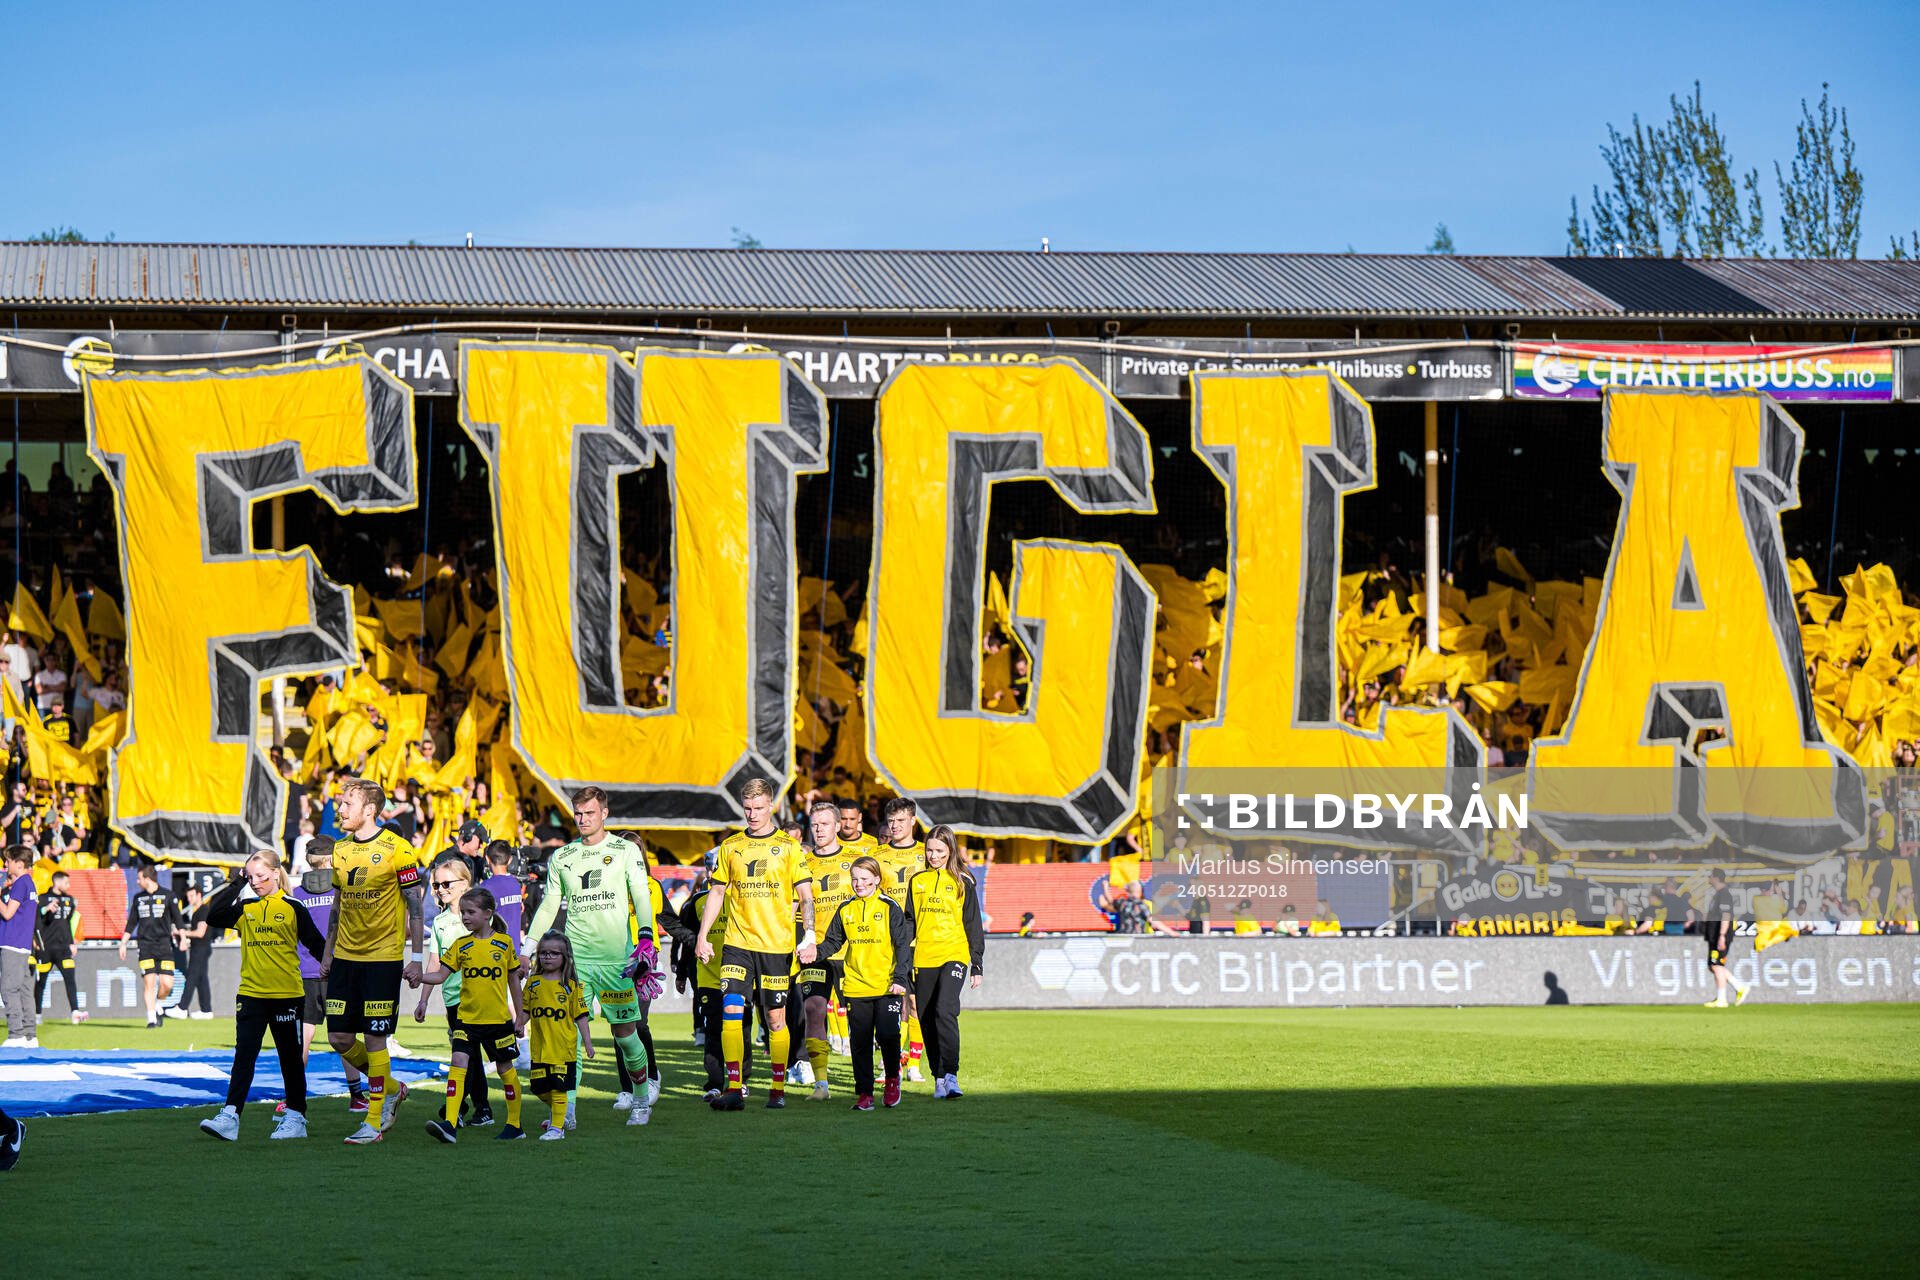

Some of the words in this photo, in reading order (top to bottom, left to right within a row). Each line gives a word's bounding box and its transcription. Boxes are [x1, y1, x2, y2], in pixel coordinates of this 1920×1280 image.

[1121, 357, 1189, 376] Private
[1418, 359, 1493, 379] Turbuss
[203, 875, 213, 892] 3
[572, 891, 616, 904] Romerike
[1442, 879, 1491, 912] Gate
[464, 966, 502, 981] coop
[1111, 951, 1200, 995] CTC
[1219, 951, 1485, 1004] Bilpartner
[1588, 949, 1635, 989] Vi
[1733, 950, 1819, 996] deg
[1837, 957, 1893, 988] en
[531, 1005, 567, 1022] coop
[615, 1009, 628, 1019] 12
[370, 1019, 386, 1032] 23
